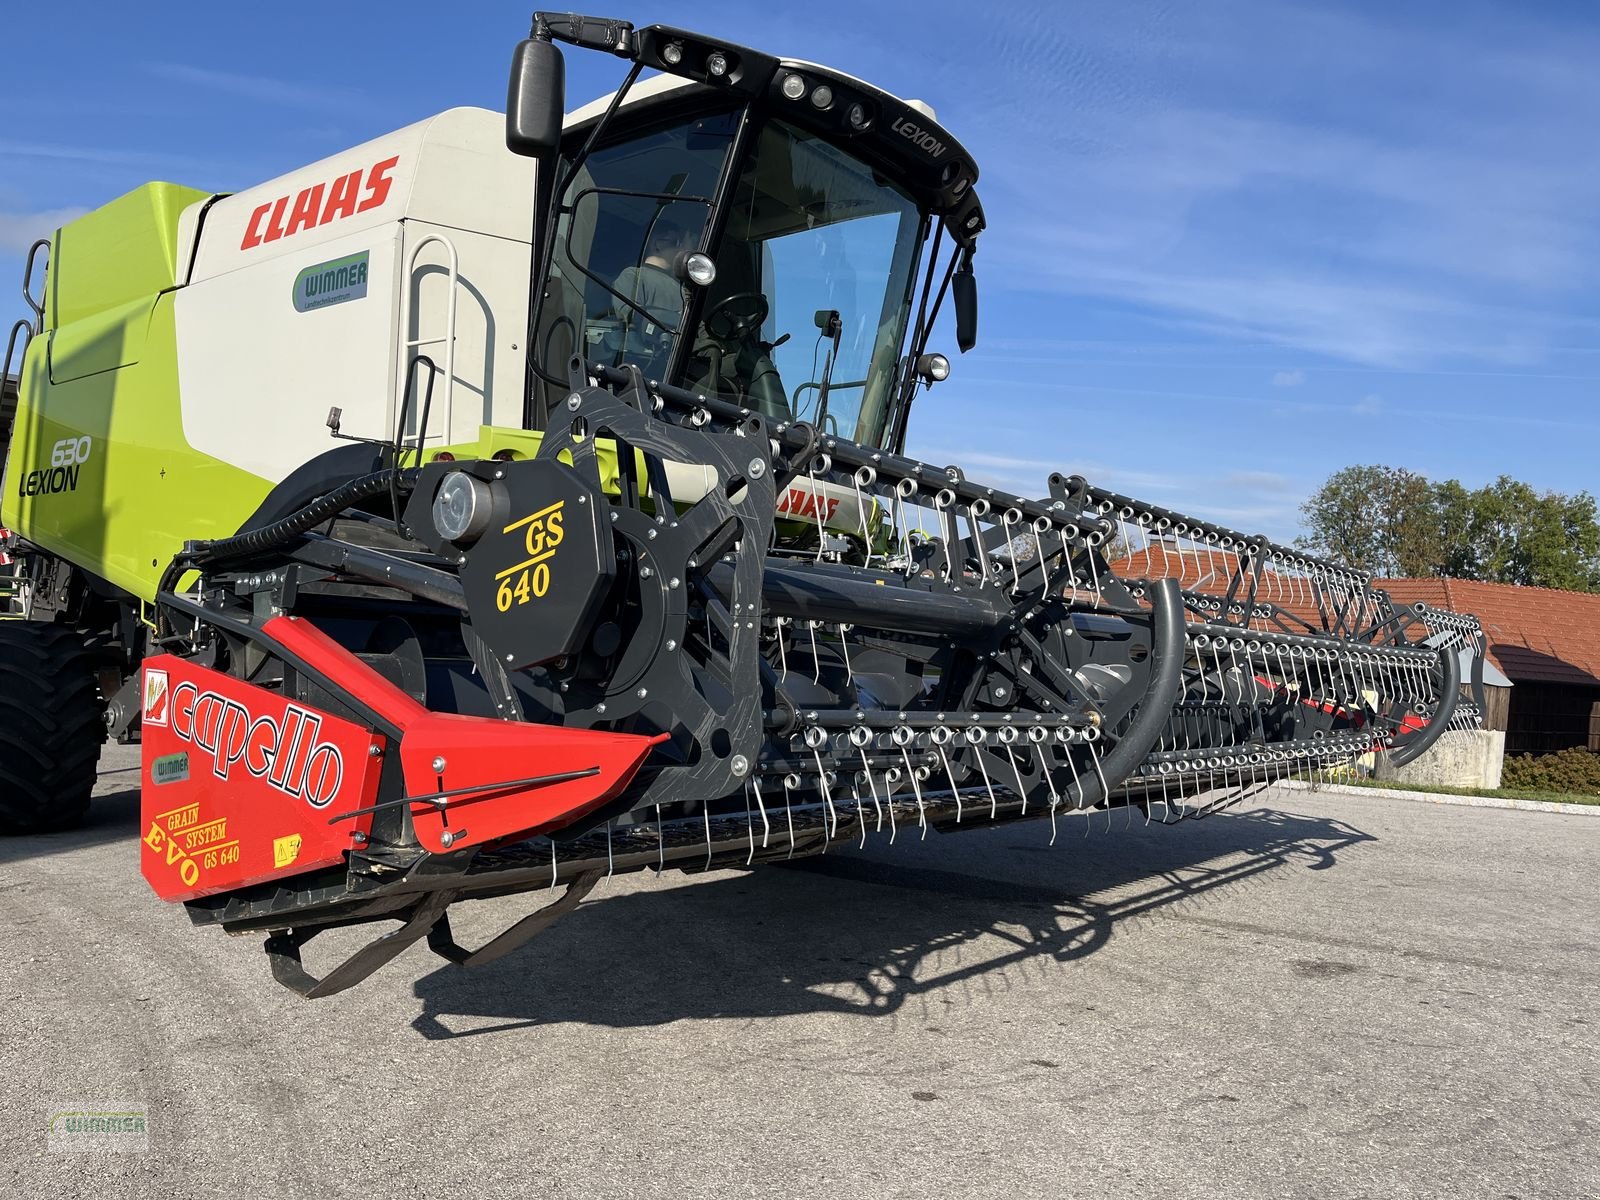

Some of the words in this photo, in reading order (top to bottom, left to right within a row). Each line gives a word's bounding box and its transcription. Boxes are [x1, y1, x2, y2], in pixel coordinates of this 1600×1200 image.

[891, 117, 947, 158] LEXION
[240, 154, 400, 251] CLAAS
[305, 262, 367, 297] WIMMER
[51, 435, 92, 467] 630
[19, 464, 80, 497] LEXION
[776, 488, 840, 521] AAS
[525, 510, 564, 555] GS
[496, 563, 550, 612] 640
[158, 758, 188, 776] WIMMER
[168, 807, 199, 831] GRAIN
[186, 822, 226, 849] SYSTEM
[143, 821, 199, 886] EVO
[204, 851, 218, 869] GS
[220, 845, 240, 866] 640
